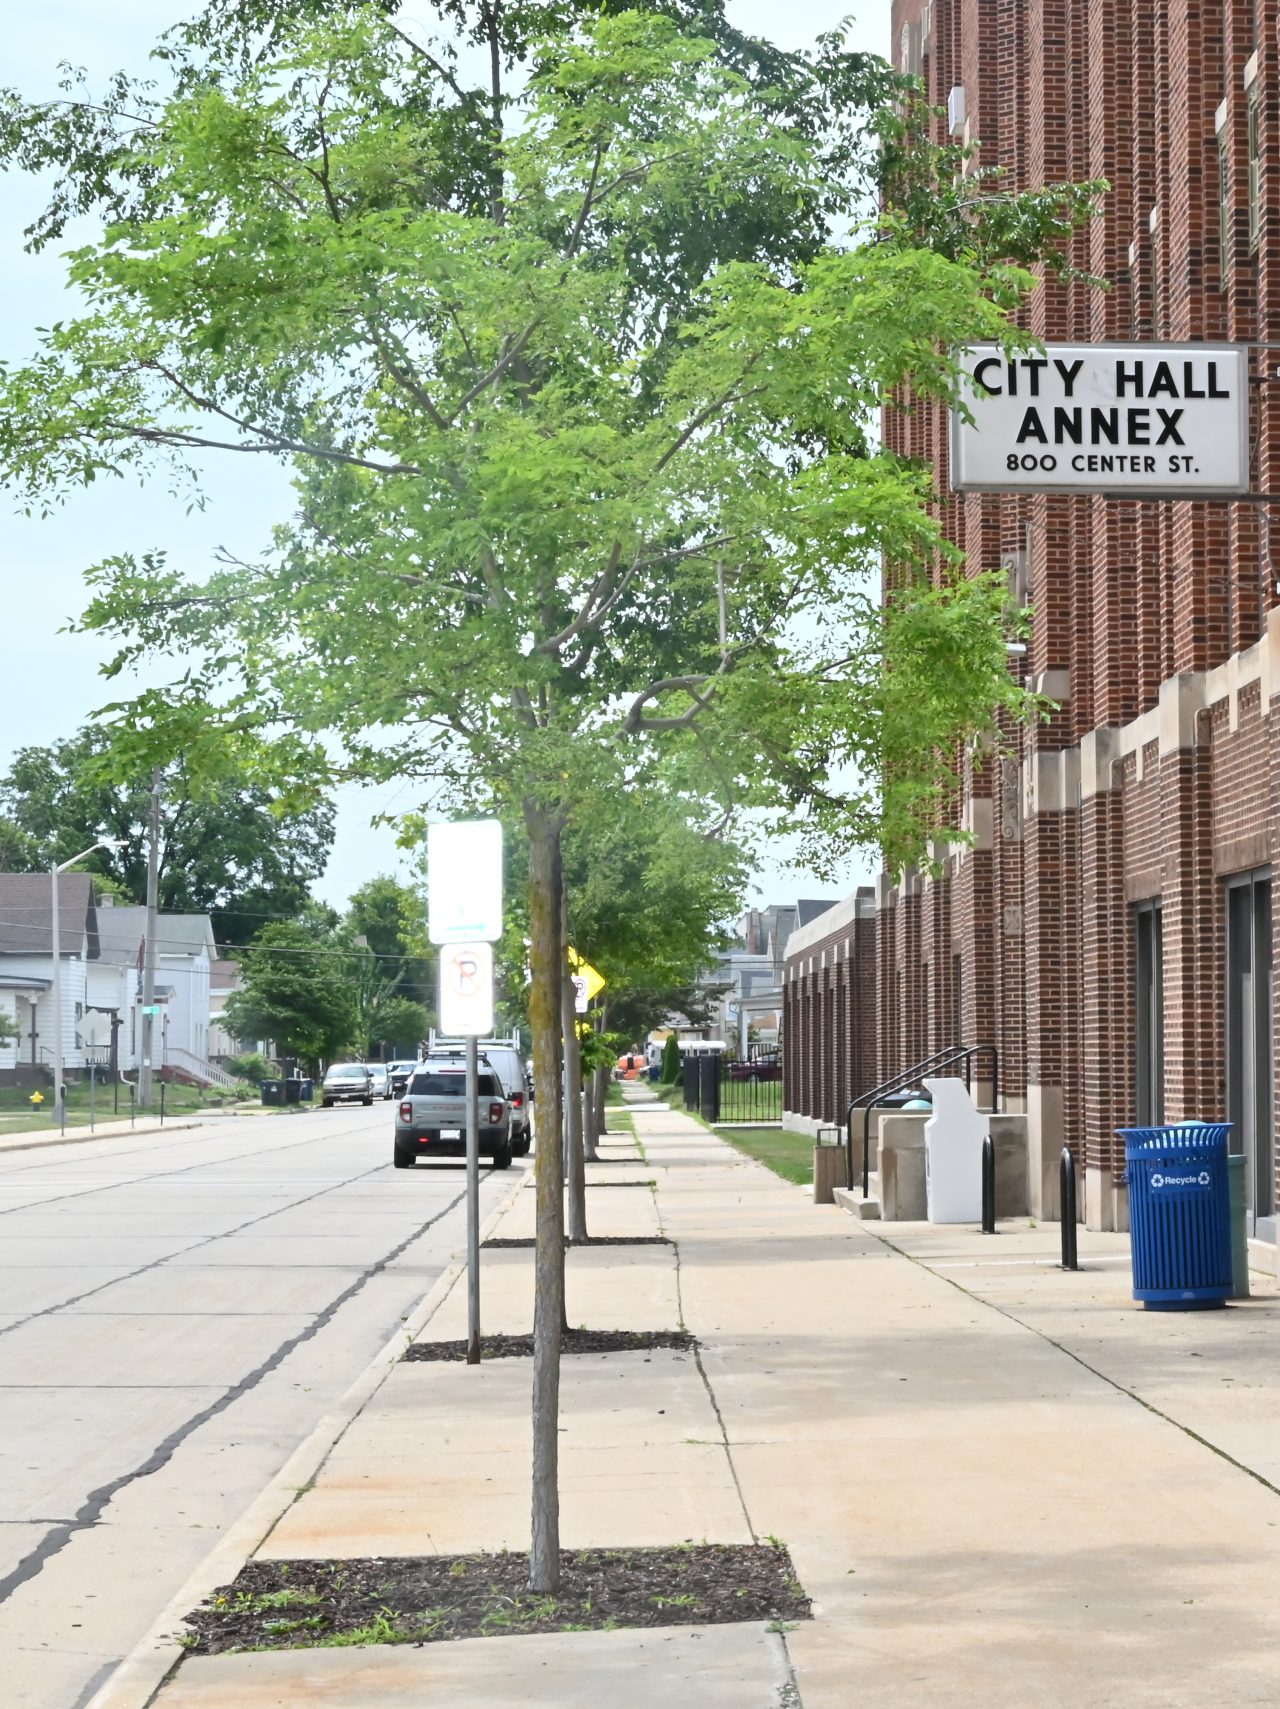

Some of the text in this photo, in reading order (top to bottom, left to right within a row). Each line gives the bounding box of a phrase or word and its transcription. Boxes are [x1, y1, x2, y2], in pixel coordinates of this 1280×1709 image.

[973, 357, 1230, 399] CITY HALL
[1016, 406, 1186, 446] ANNEX
[1006, 453, 1200, 473] 800 CENTER ST.
[1164, 1175, 1197, 1186] Recycle
